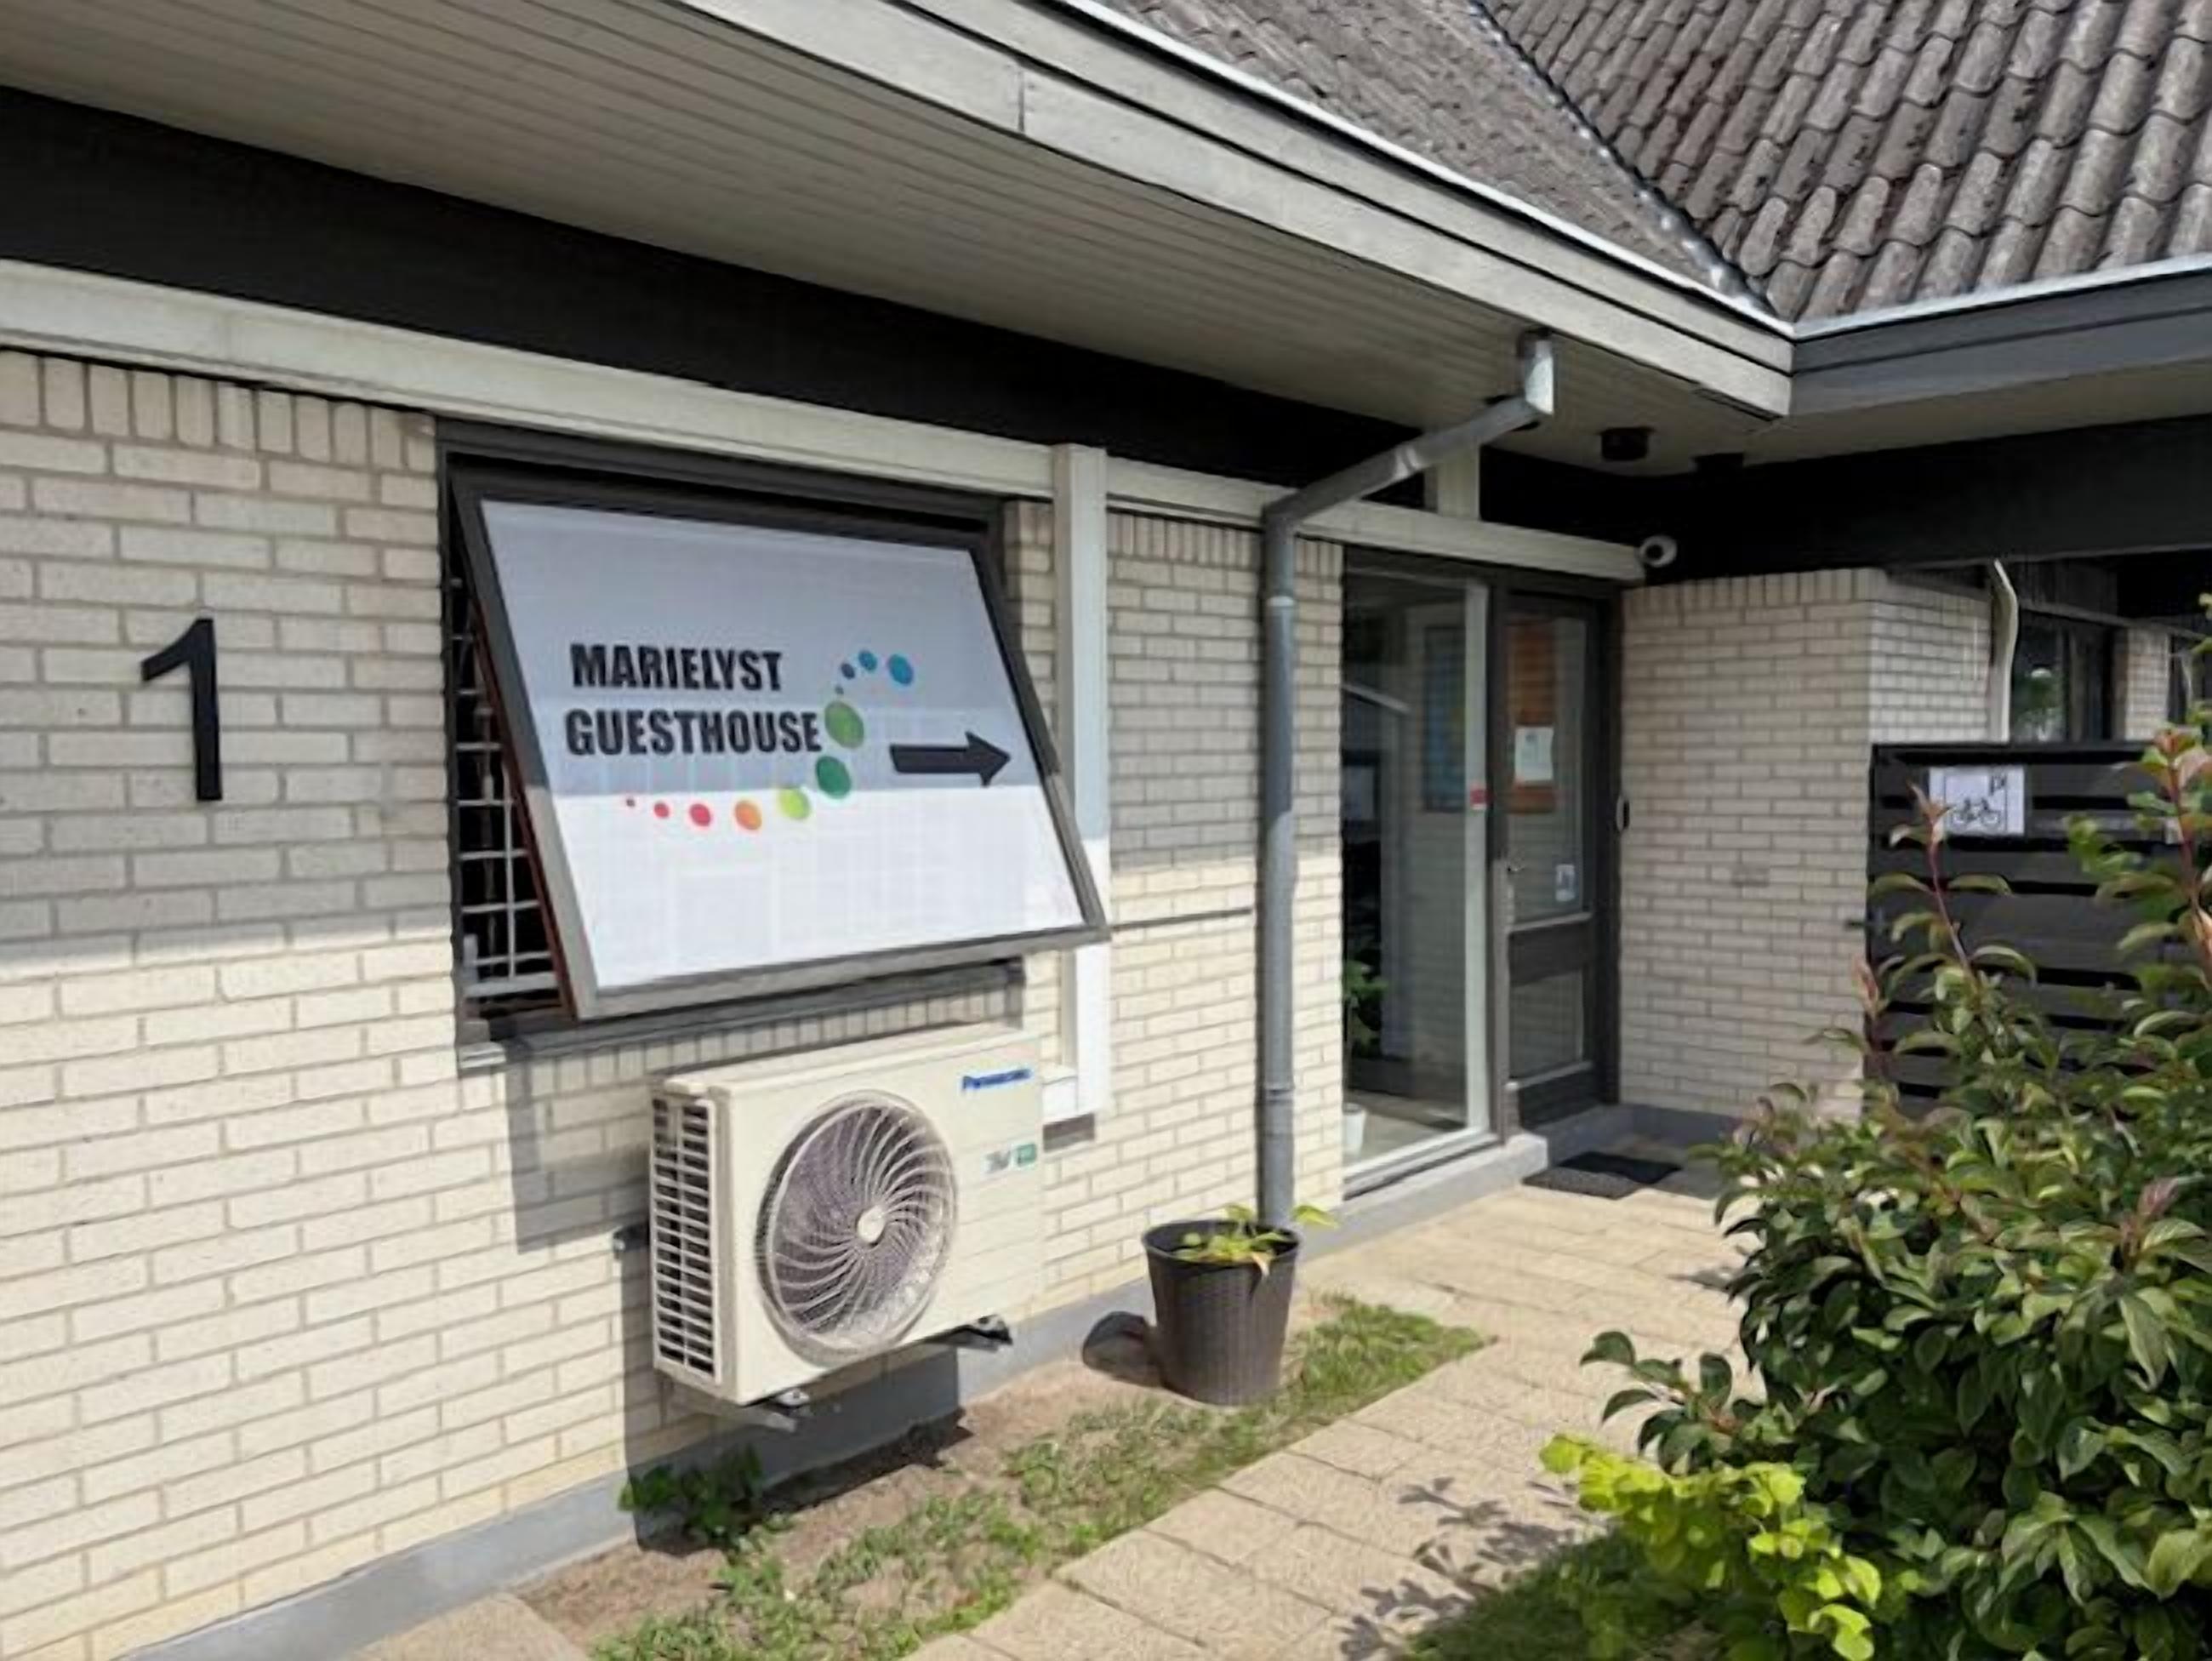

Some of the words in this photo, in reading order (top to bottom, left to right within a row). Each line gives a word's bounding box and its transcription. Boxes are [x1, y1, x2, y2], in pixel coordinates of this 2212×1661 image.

[570, 643, 782, 691] MARIELYST
[141, 618, 222, 802] 1
[566, 709, 822, 755] GUESTHOUSE
